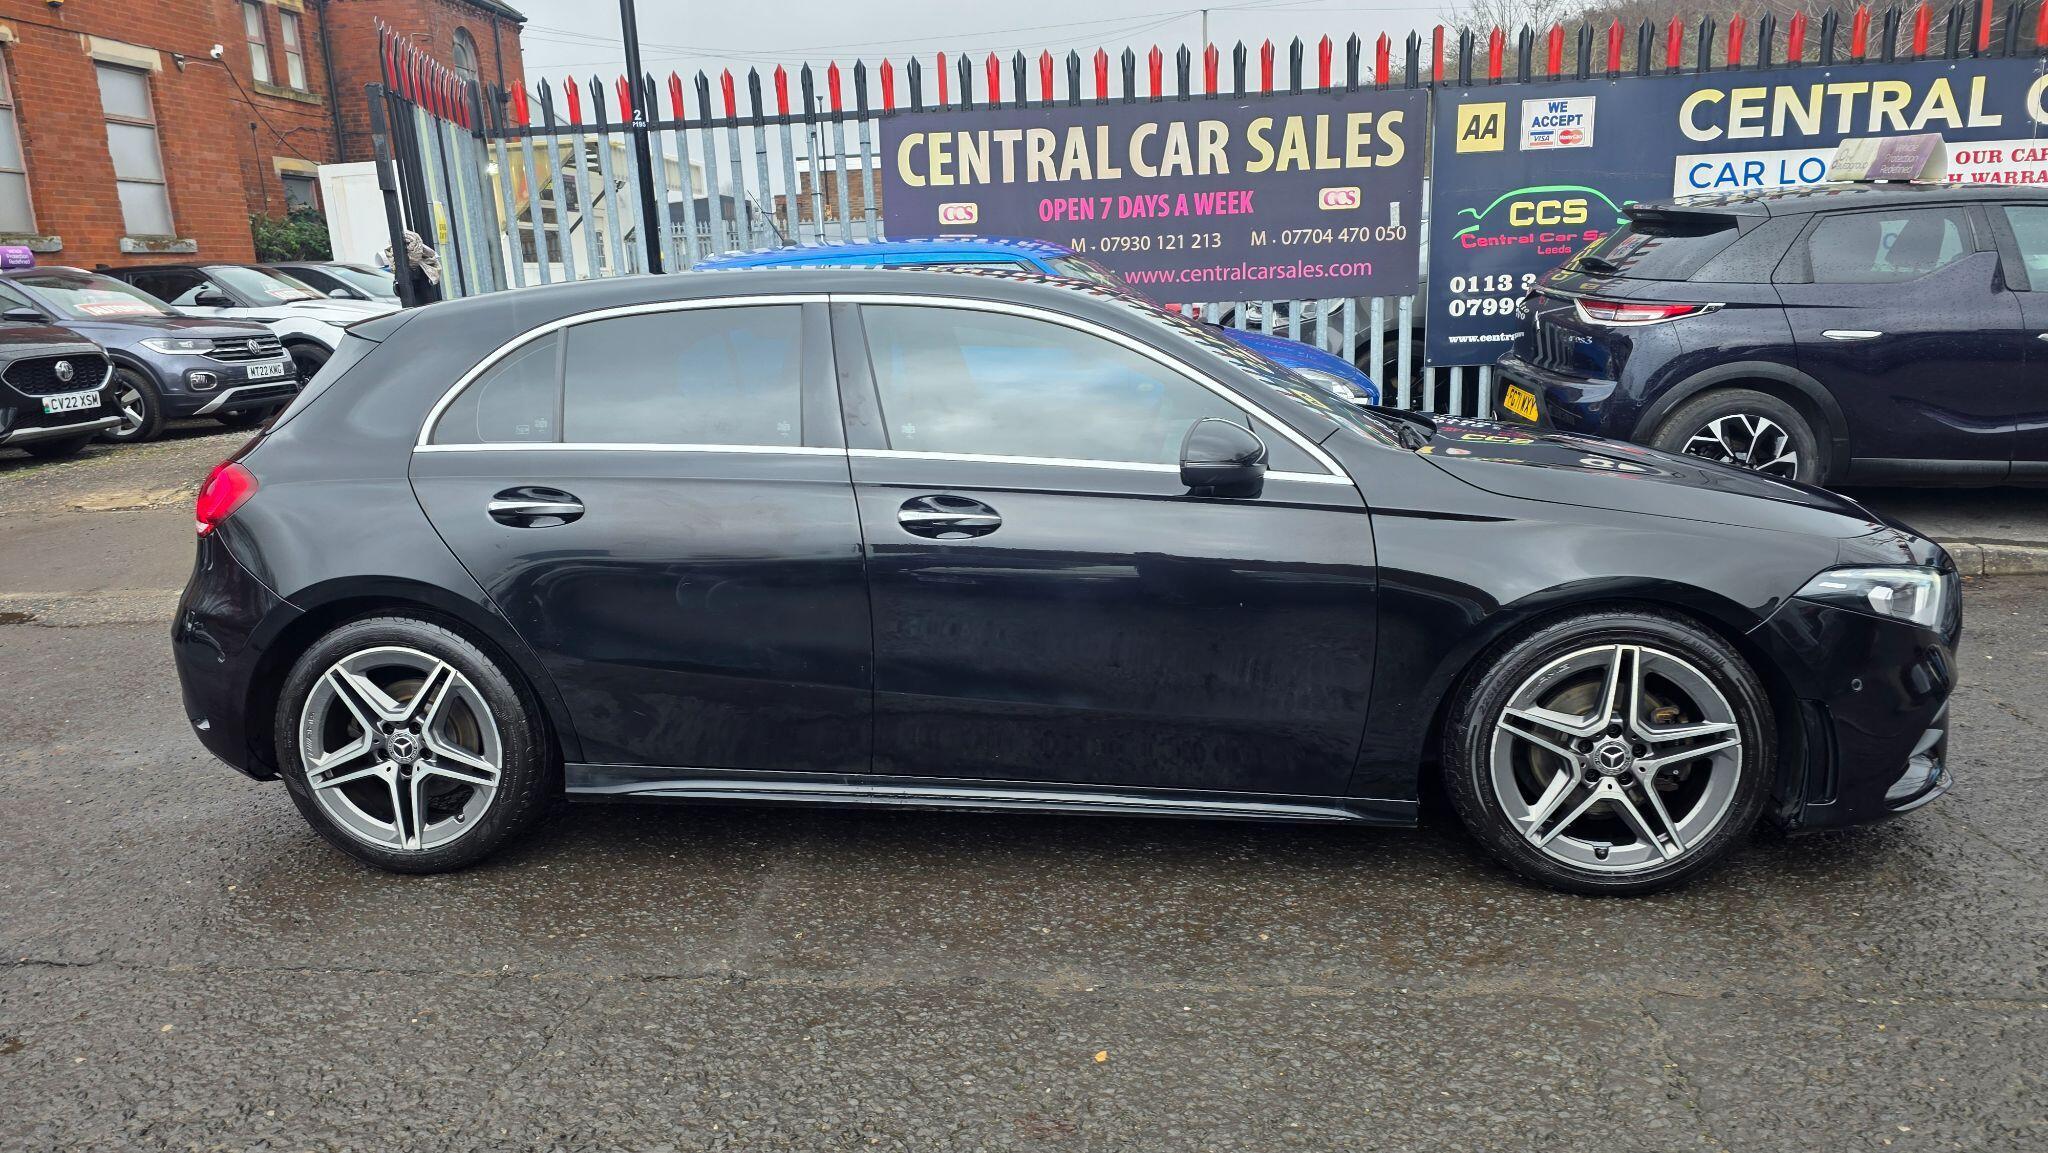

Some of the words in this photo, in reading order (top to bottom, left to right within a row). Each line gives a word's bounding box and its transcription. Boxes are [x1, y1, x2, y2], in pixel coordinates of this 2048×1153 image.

[633, 109, 642, 121] 2
[1547, 101, 1569, 114] WE
[1679, 75, 2003, 142] CENTRAL
[1462, 113, 1499, 141] AA
[1531, 113, 1584, 128] ACCEPT
[897, 125, 1122, 187] CENTRAL
[1129, 121, 1230, 177] CAR
[1245, 110, 1406, 172] SALES
[1955, 149, 2004, 165] OUR
[1689, 160, 1766, 189] CAR
[1039, 196, 1095, 222] OPEN
[1100, 196, 1113, 220] 7
[1118, 194, 1170, 219] DAYS
[1174, 193, 1190, 217] A
[1193, 190, 1255, 215] WEEK
[1323, 189, 1356, 206] CCS
[943, 205, 974, 222] CCS
[1509, 198, 1588, 227] CCS
[1070, 238, 1087, 253] M
[1100, 235, 1151, 251] 07930
[1157, 234, 1185, 250] 121
[1191, 232, 1222, 249] 213
[1250, 230, 1267, 246] M
[1281, 228, 1334, 245] 07704
[1338, 226, 1370, 243] 470
[1375, 225, 1407, 242] 050
[1460, 232, 1534, 249] Central
[1539, 232, 1578, 243] Car
[1537, 245, 1572, 255] Leeds
[1125, 259, 1373, 284] www.centralcarsales.com
[1449, 274, 1513, 293] 0113
[51, 396, 79, 410] CV22
[80, 393, 99, 406] XSM
